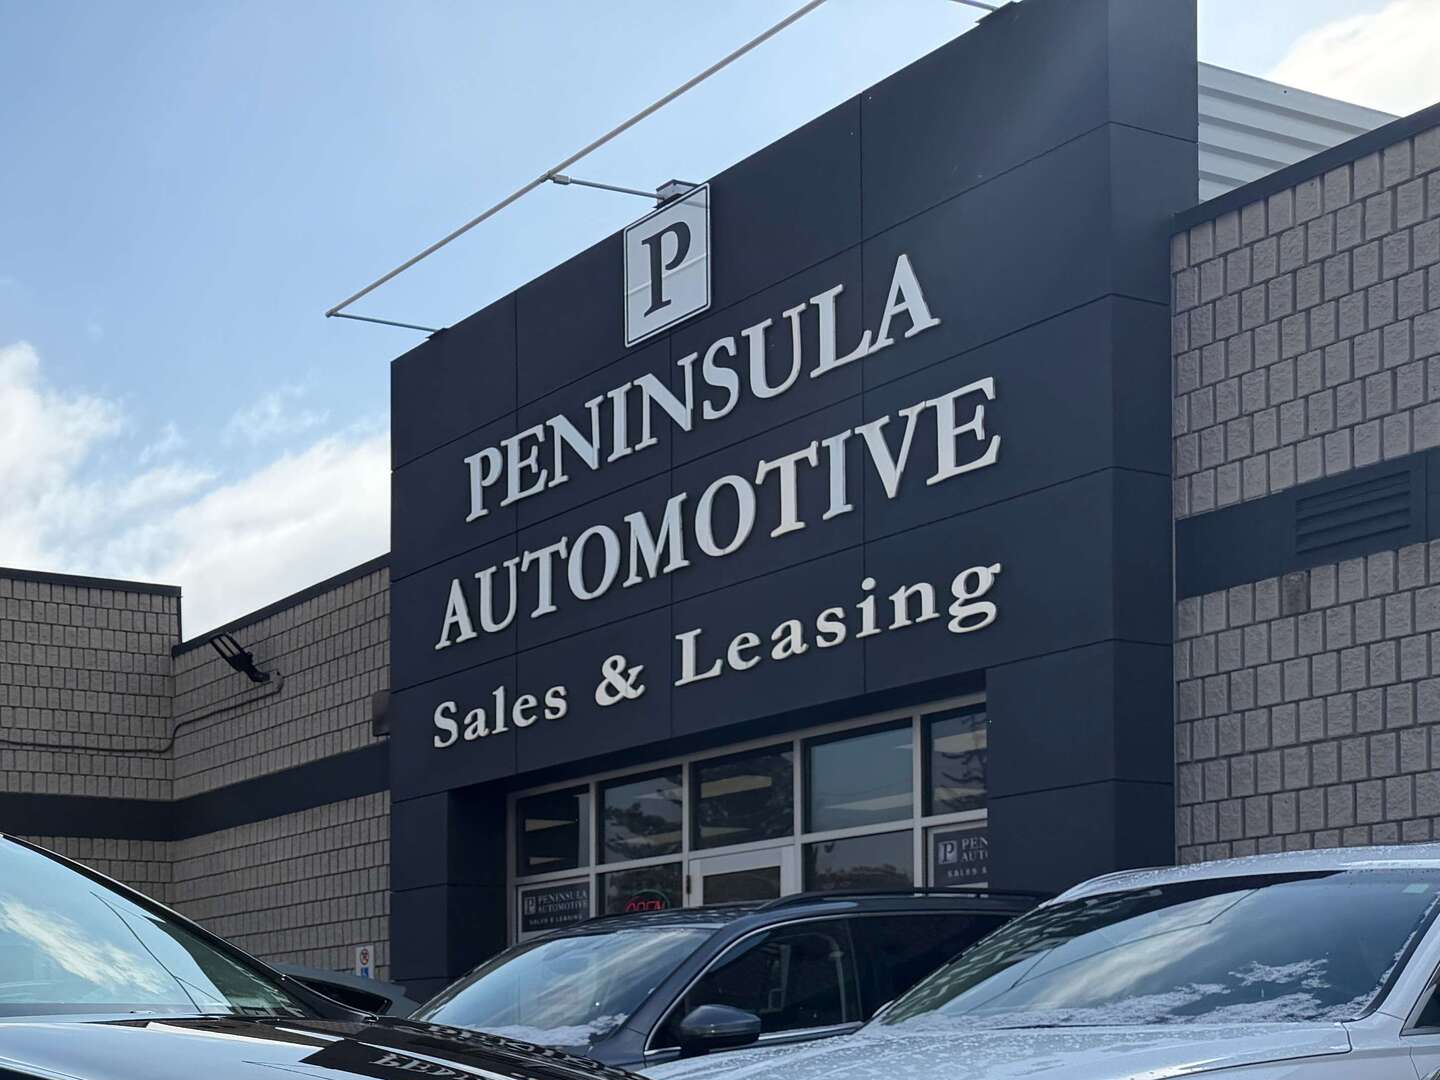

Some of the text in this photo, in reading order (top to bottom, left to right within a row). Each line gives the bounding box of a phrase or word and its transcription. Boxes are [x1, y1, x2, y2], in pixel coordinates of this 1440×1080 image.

[641, 221, 692, 318] P
[464, 253, 942, 522] PENINSULA
[434, 376, 1002, 650] AUTOMOTIVE
[433, 562, 1002, 749] Sales & Leasing
